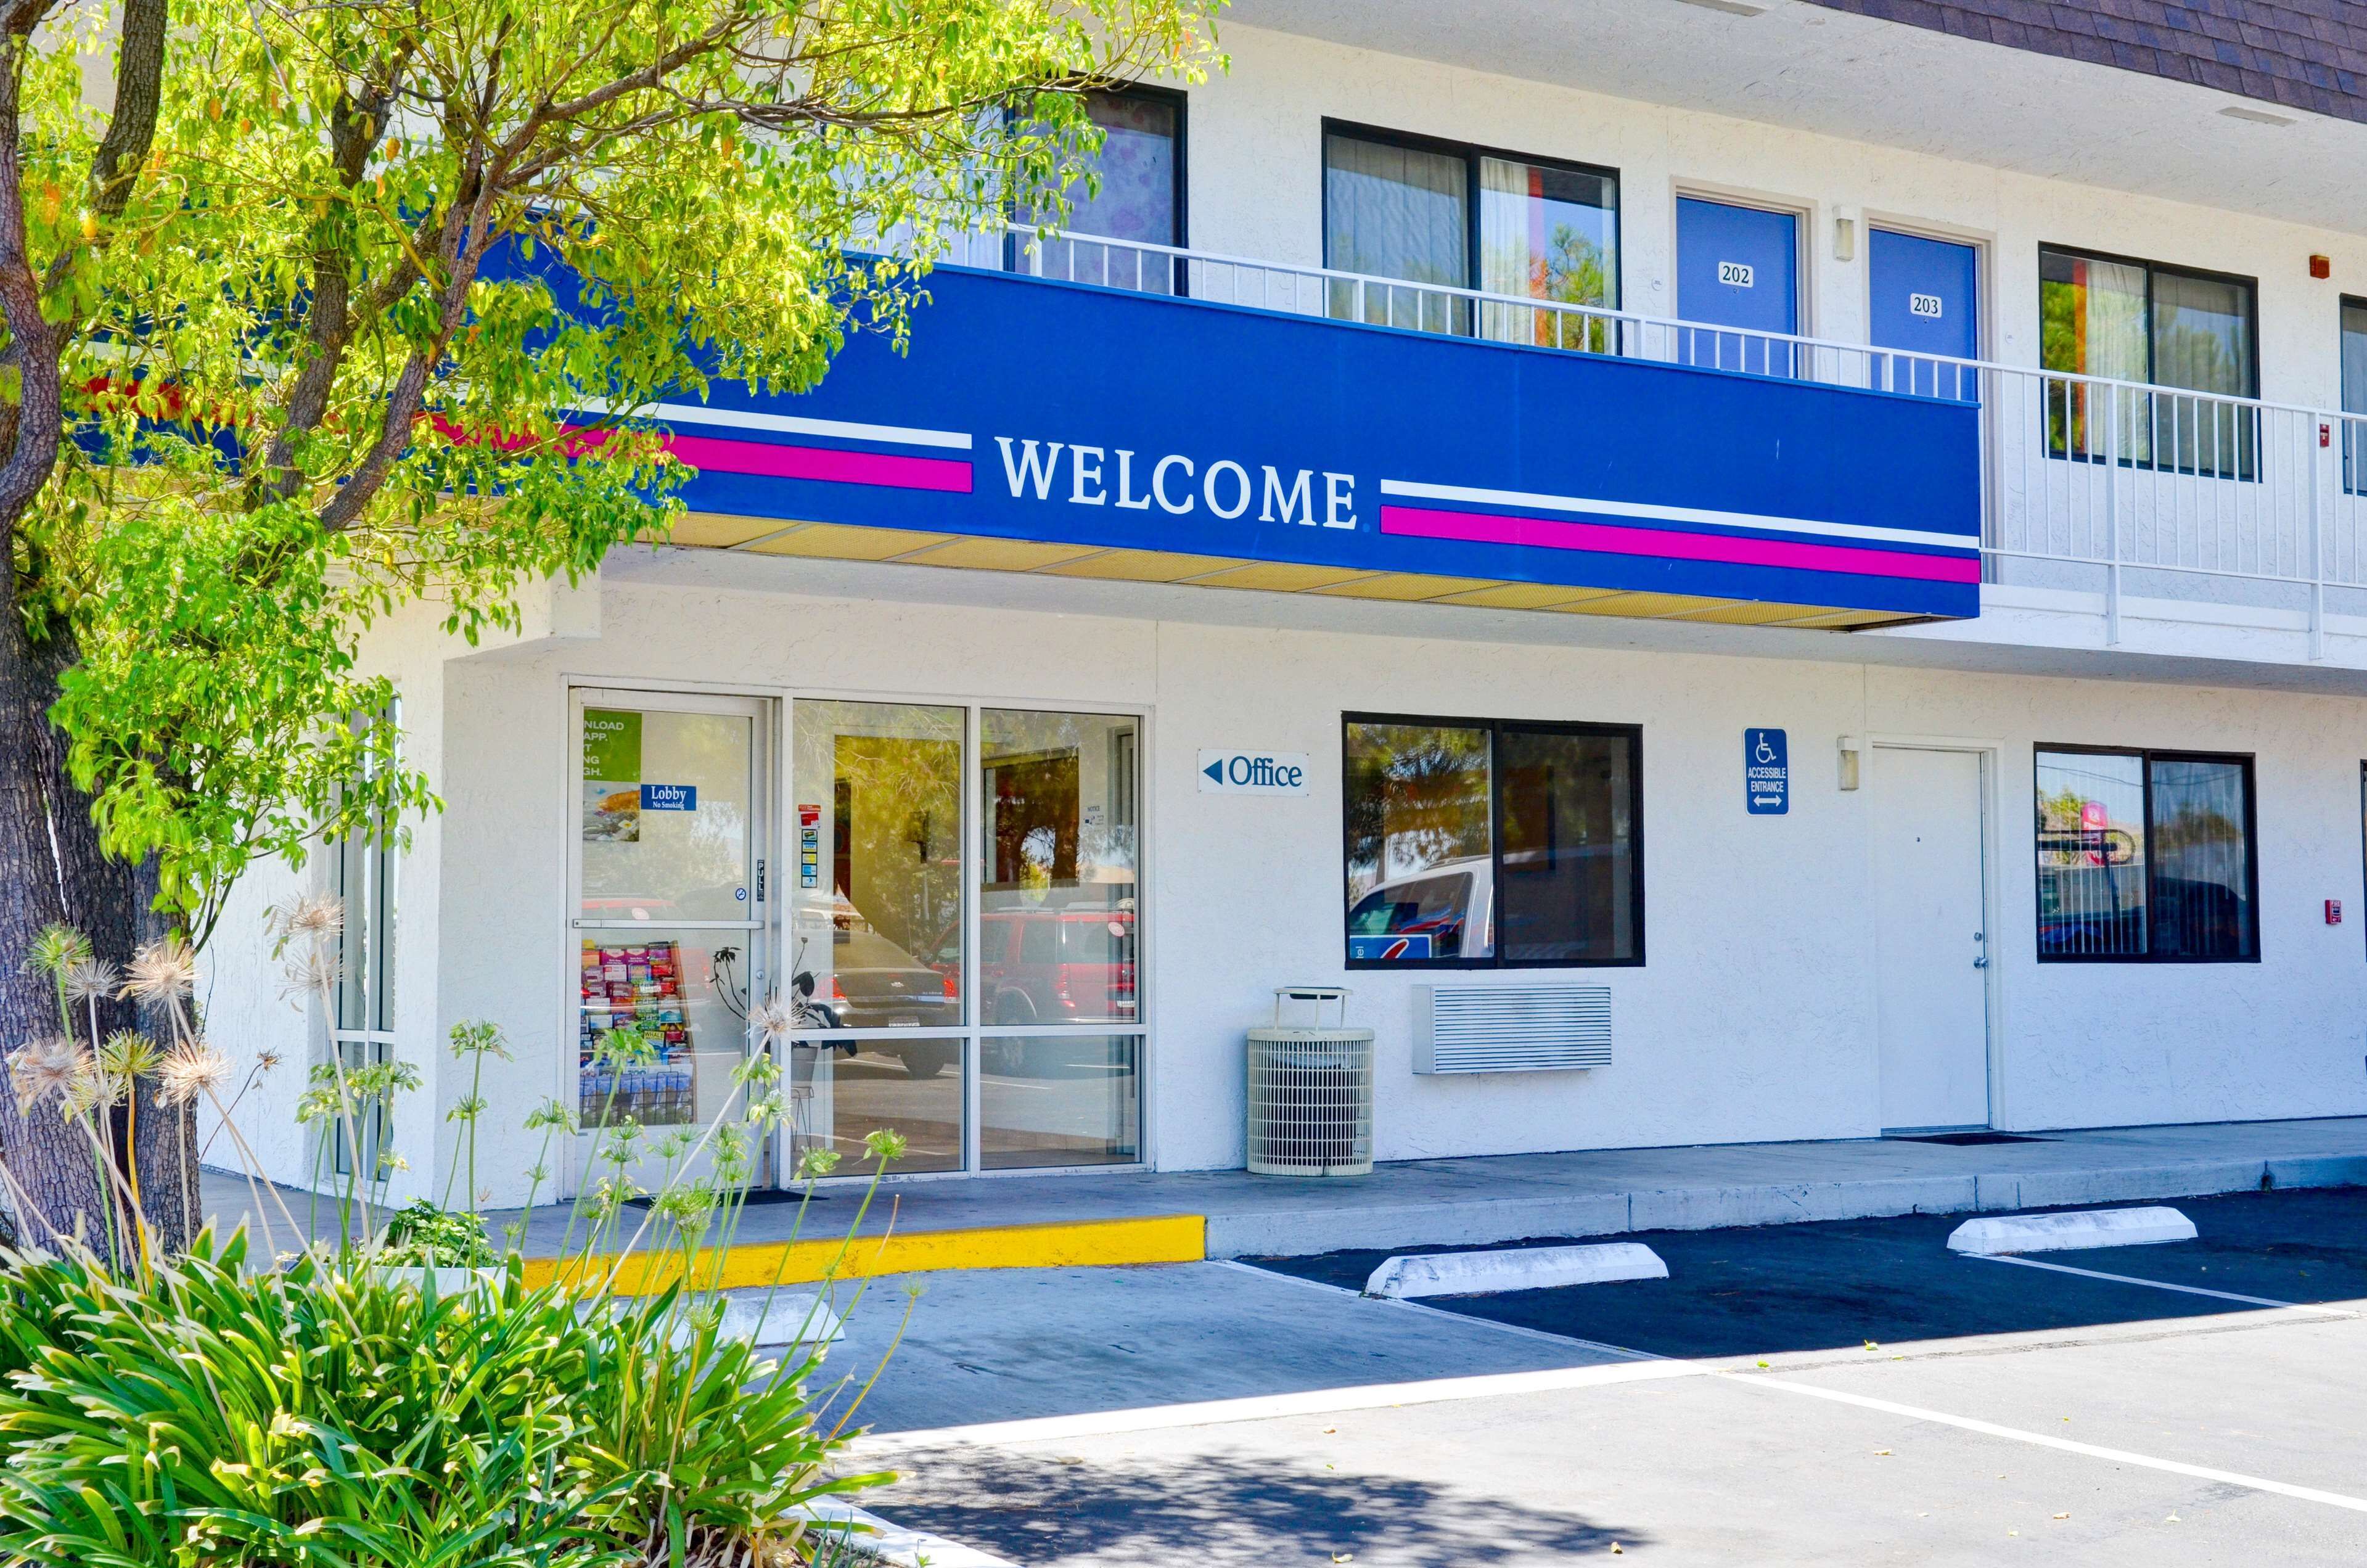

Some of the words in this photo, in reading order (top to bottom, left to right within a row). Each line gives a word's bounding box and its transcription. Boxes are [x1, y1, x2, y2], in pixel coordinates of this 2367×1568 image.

[1722, 265, 1749, 284] 202
[1914, 297, 1938, 314] 203
[994, 436, 1357, 530] WELCOME
[1229, 756, 1302, 787] Office
[1748, 766, 1786, 779] ACCESSIBLE
[651, 786, 687, 804] Lobby
[1750, 781, 1784, 793] ENTRANCE
[662, 801, 684, 810] Smoking
